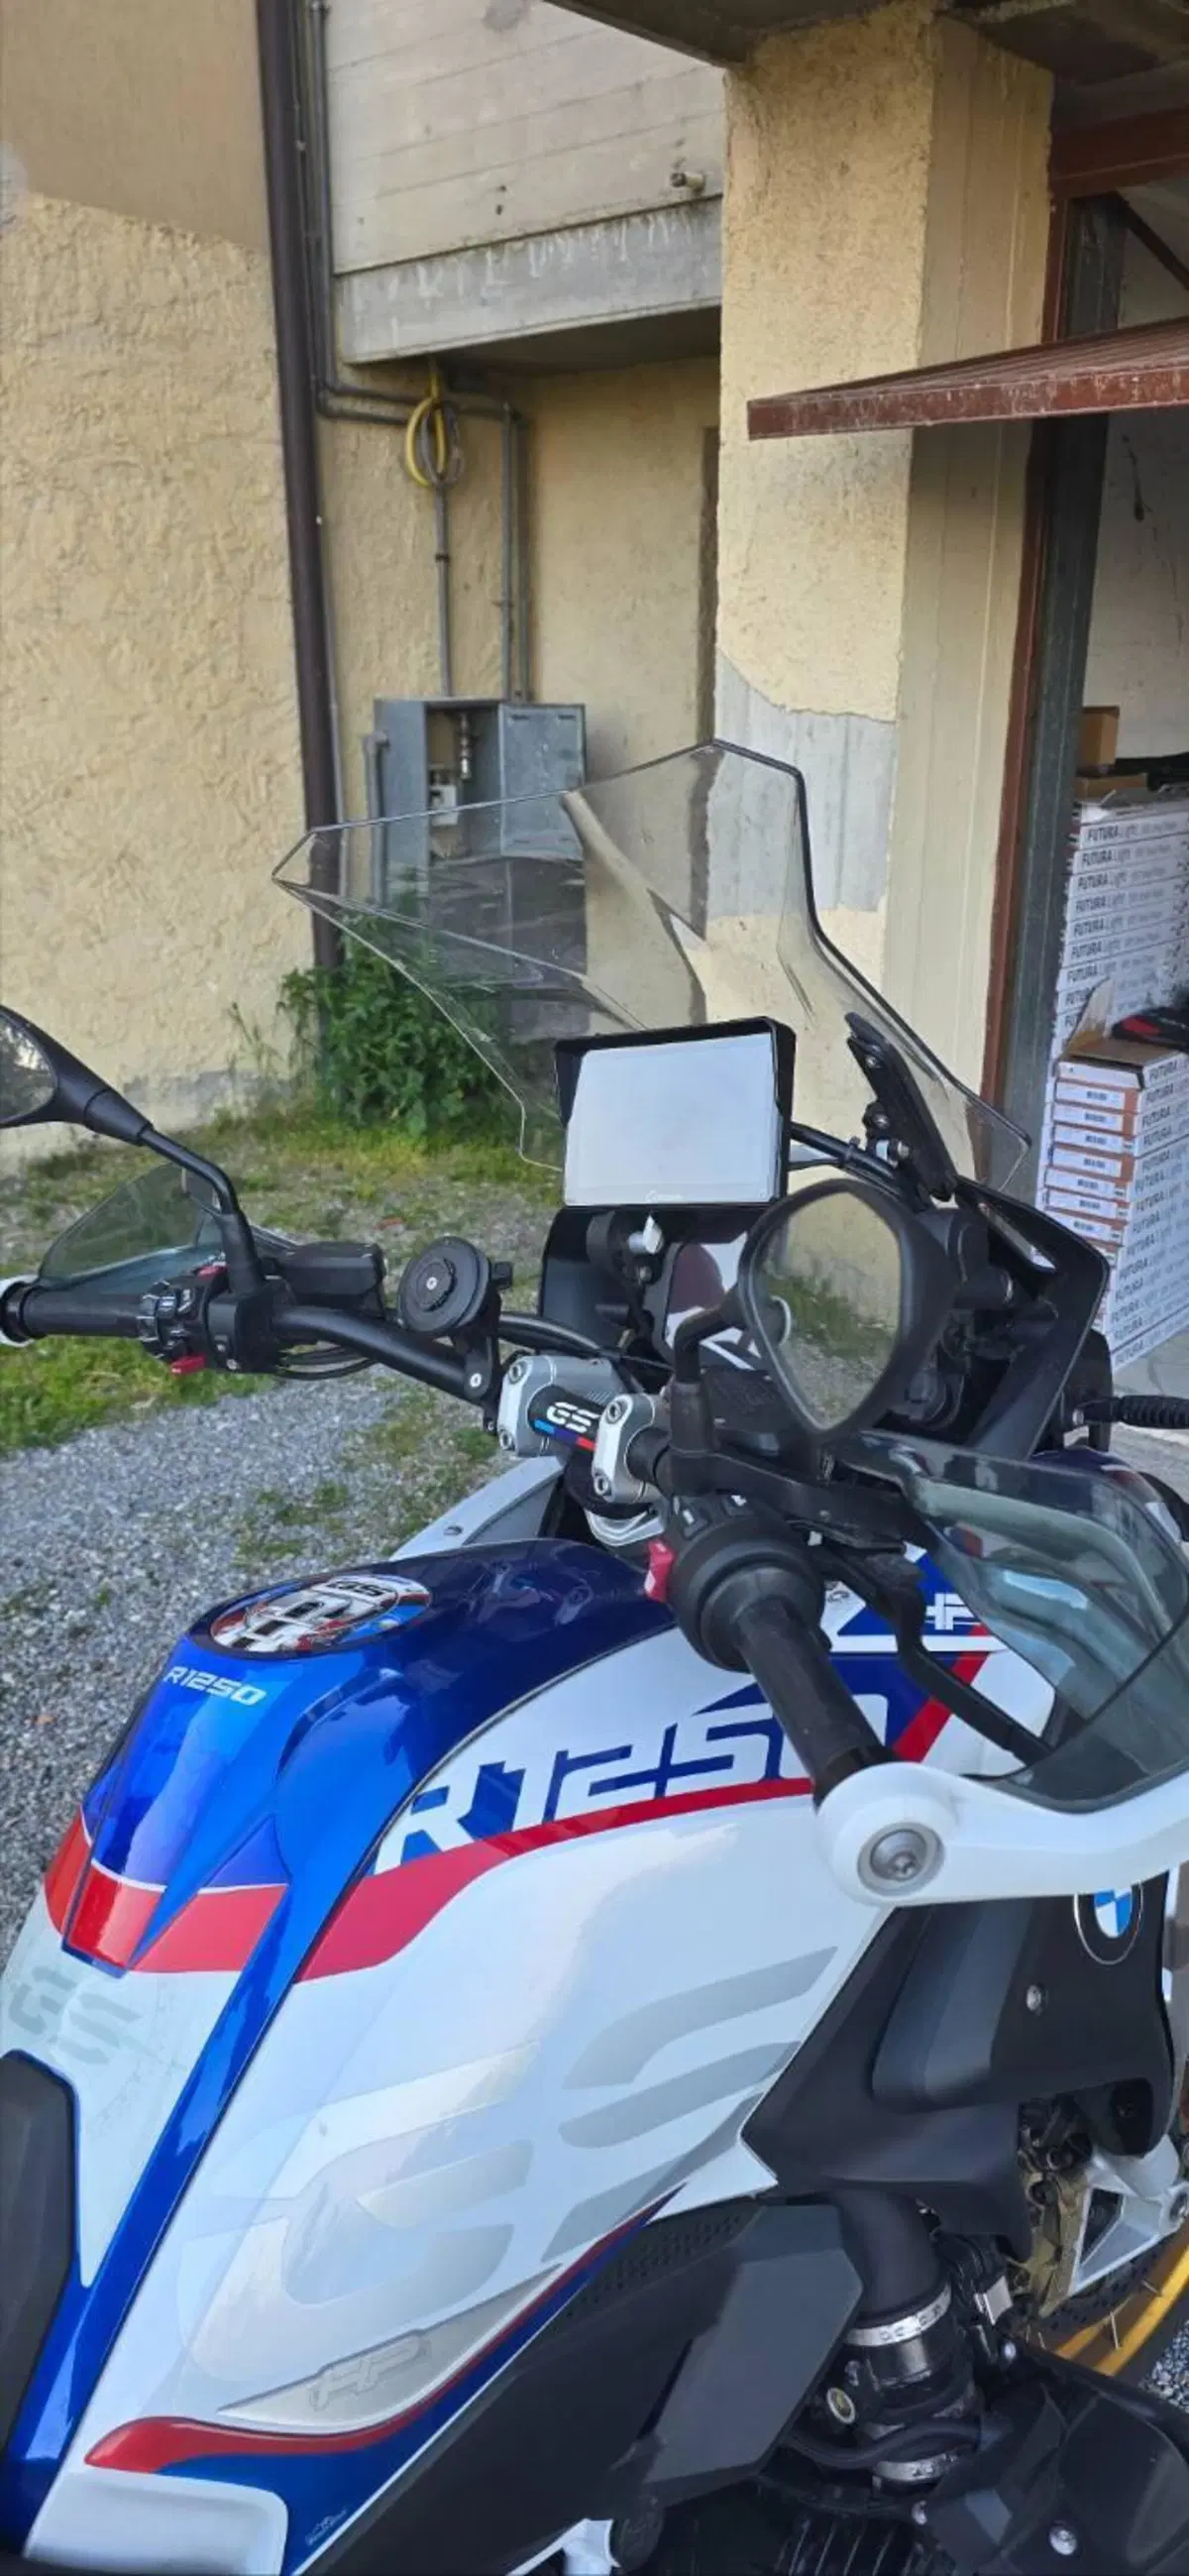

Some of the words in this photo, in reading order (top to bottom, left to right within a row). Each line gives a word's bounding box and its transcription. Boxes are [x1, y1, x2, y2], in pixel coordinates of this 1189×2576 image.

[546, 1400, 601, 1433] GS
[162, 1666, 267, 1706] R1250
[374, 1693, 889, 1875] R125
[9, 1965, 143, 2065] GS
[308, 2337, 433, 2413] HP
